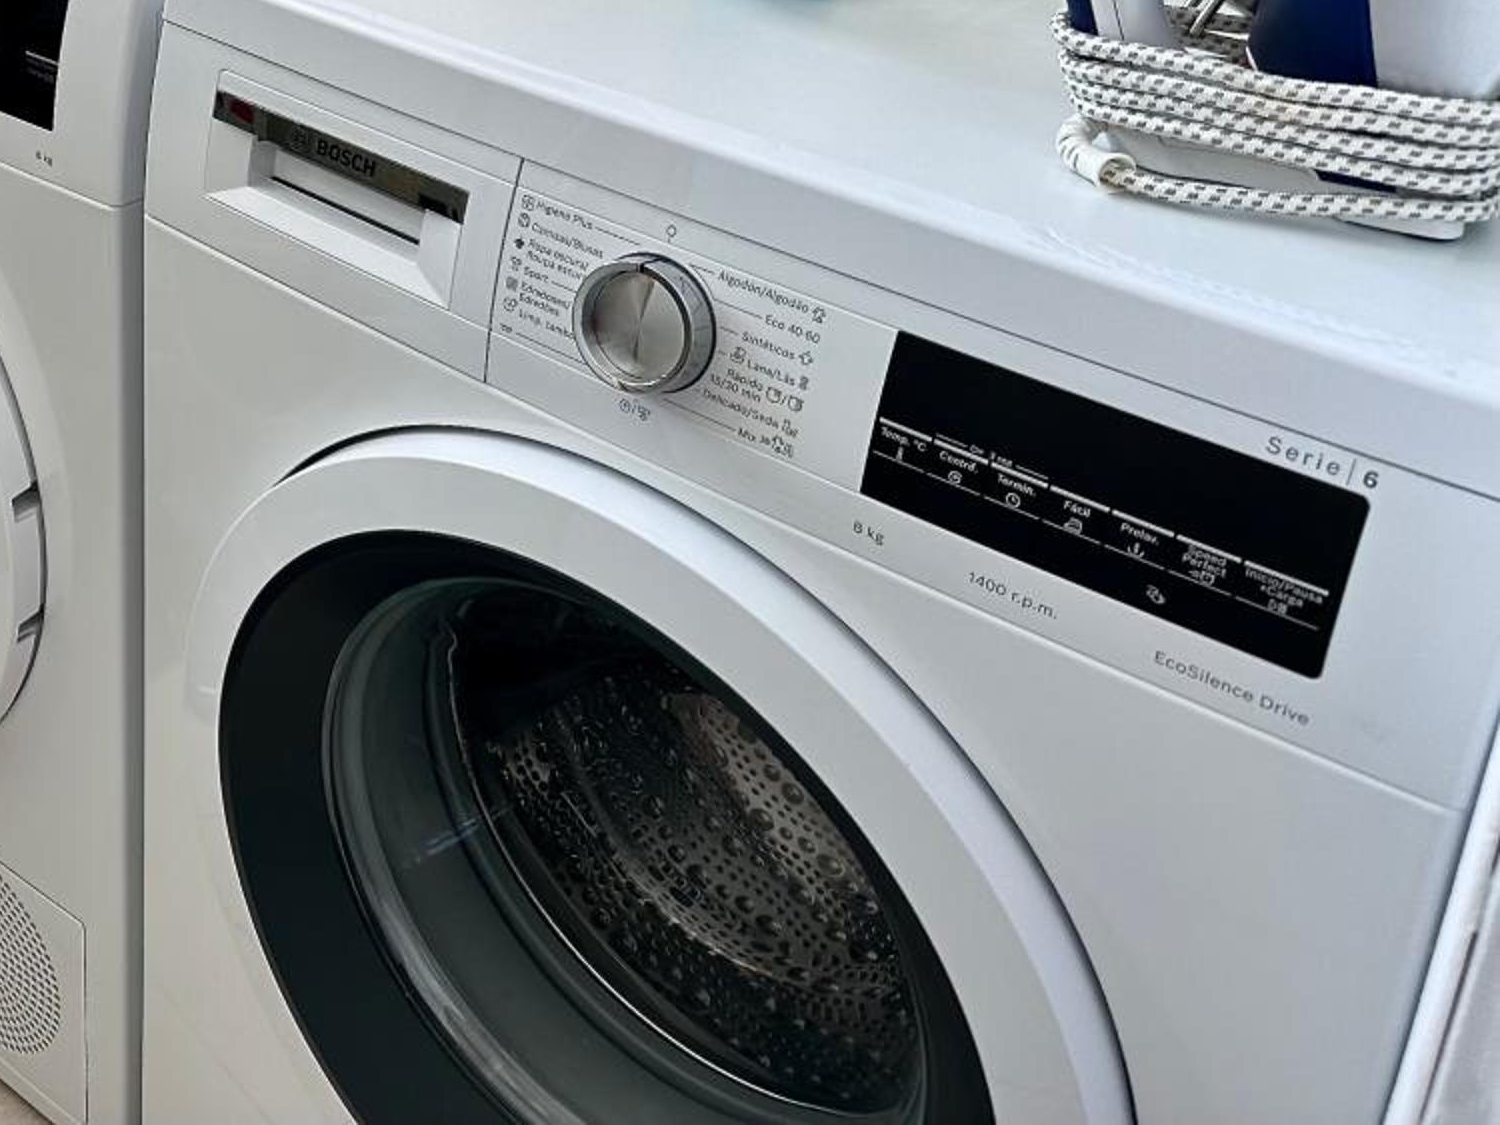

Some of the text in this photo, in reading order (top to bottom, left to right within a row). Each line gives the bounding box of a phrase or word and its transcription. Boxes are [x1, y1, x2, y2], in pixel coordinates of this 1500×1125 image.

[315, 138, 376, 177] BOSCH
[765, 314, 785, 330] Eco
[881, 426, 911, 447] Temp.
[1265, 435, 1380, 489] Serie 6
[853, 520, 885, 547] 8 kg
[1182, 551, 1227, 578] Perfect
[1187, 544, 1227, 567] Speed
[968, 571, 1058, 620] 1400 r.p.m.
[1245, 568, 1323, 604] Inicio/Pausa
[1153, 650, 1311, 725] EcoSilence Drive
